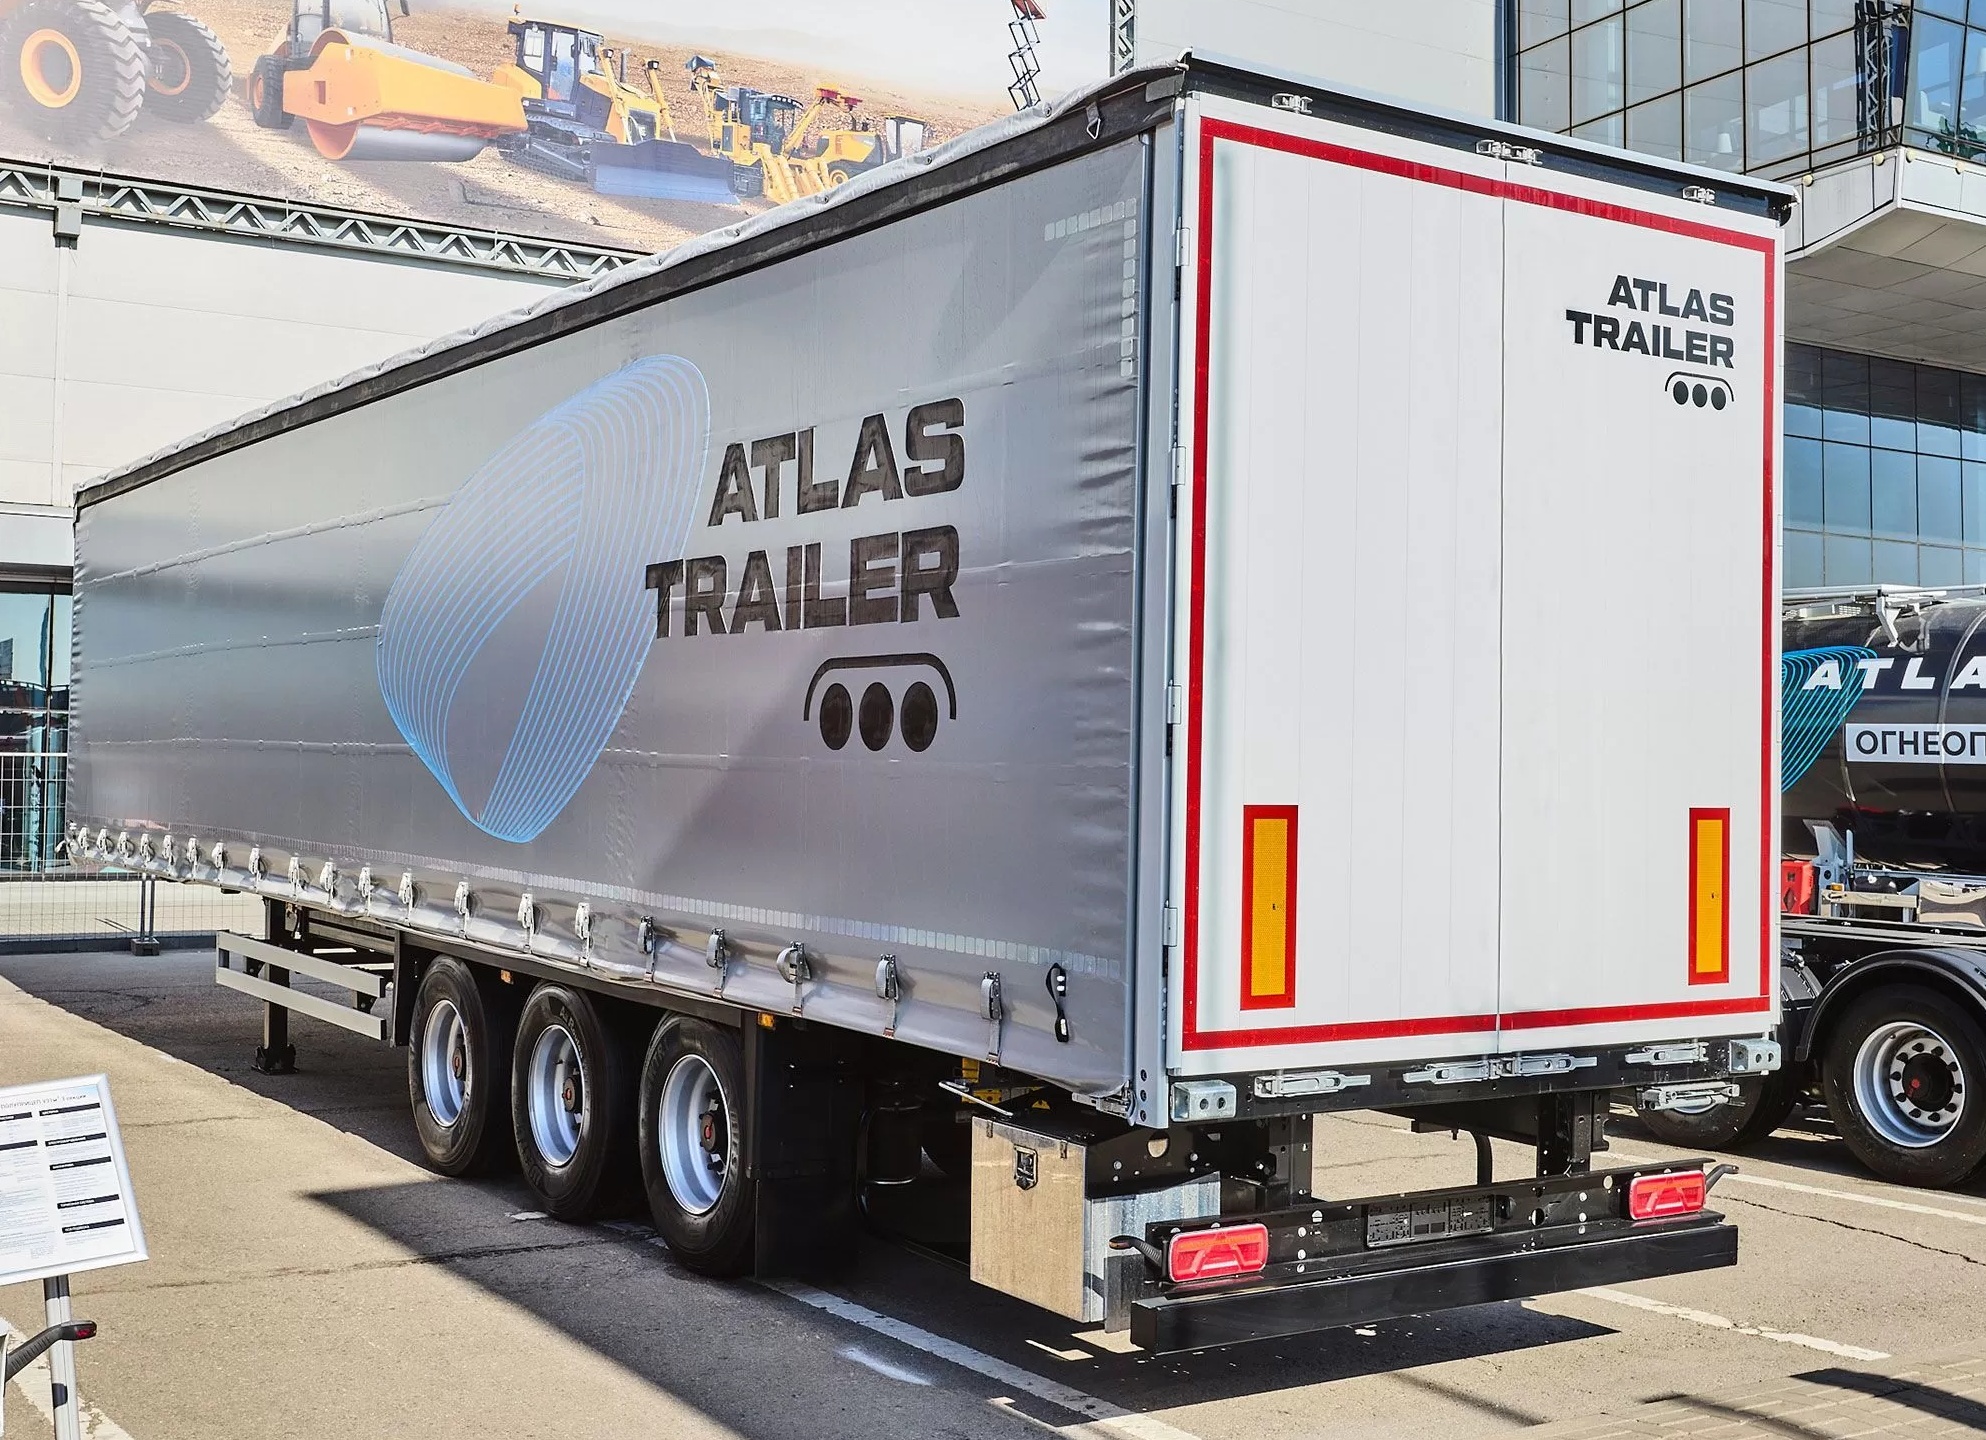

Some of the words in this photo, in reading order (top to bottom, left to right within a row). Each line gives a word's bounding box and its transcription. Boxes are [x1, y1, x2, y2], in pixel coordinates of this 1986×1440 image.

[1566, 309, 1734, 369] TRAILER
[1607, 274, 1734, 327] ATLAS
[707, 397, 964, 527] ATLAS
[645, 524, 960, 639] TRAILER
